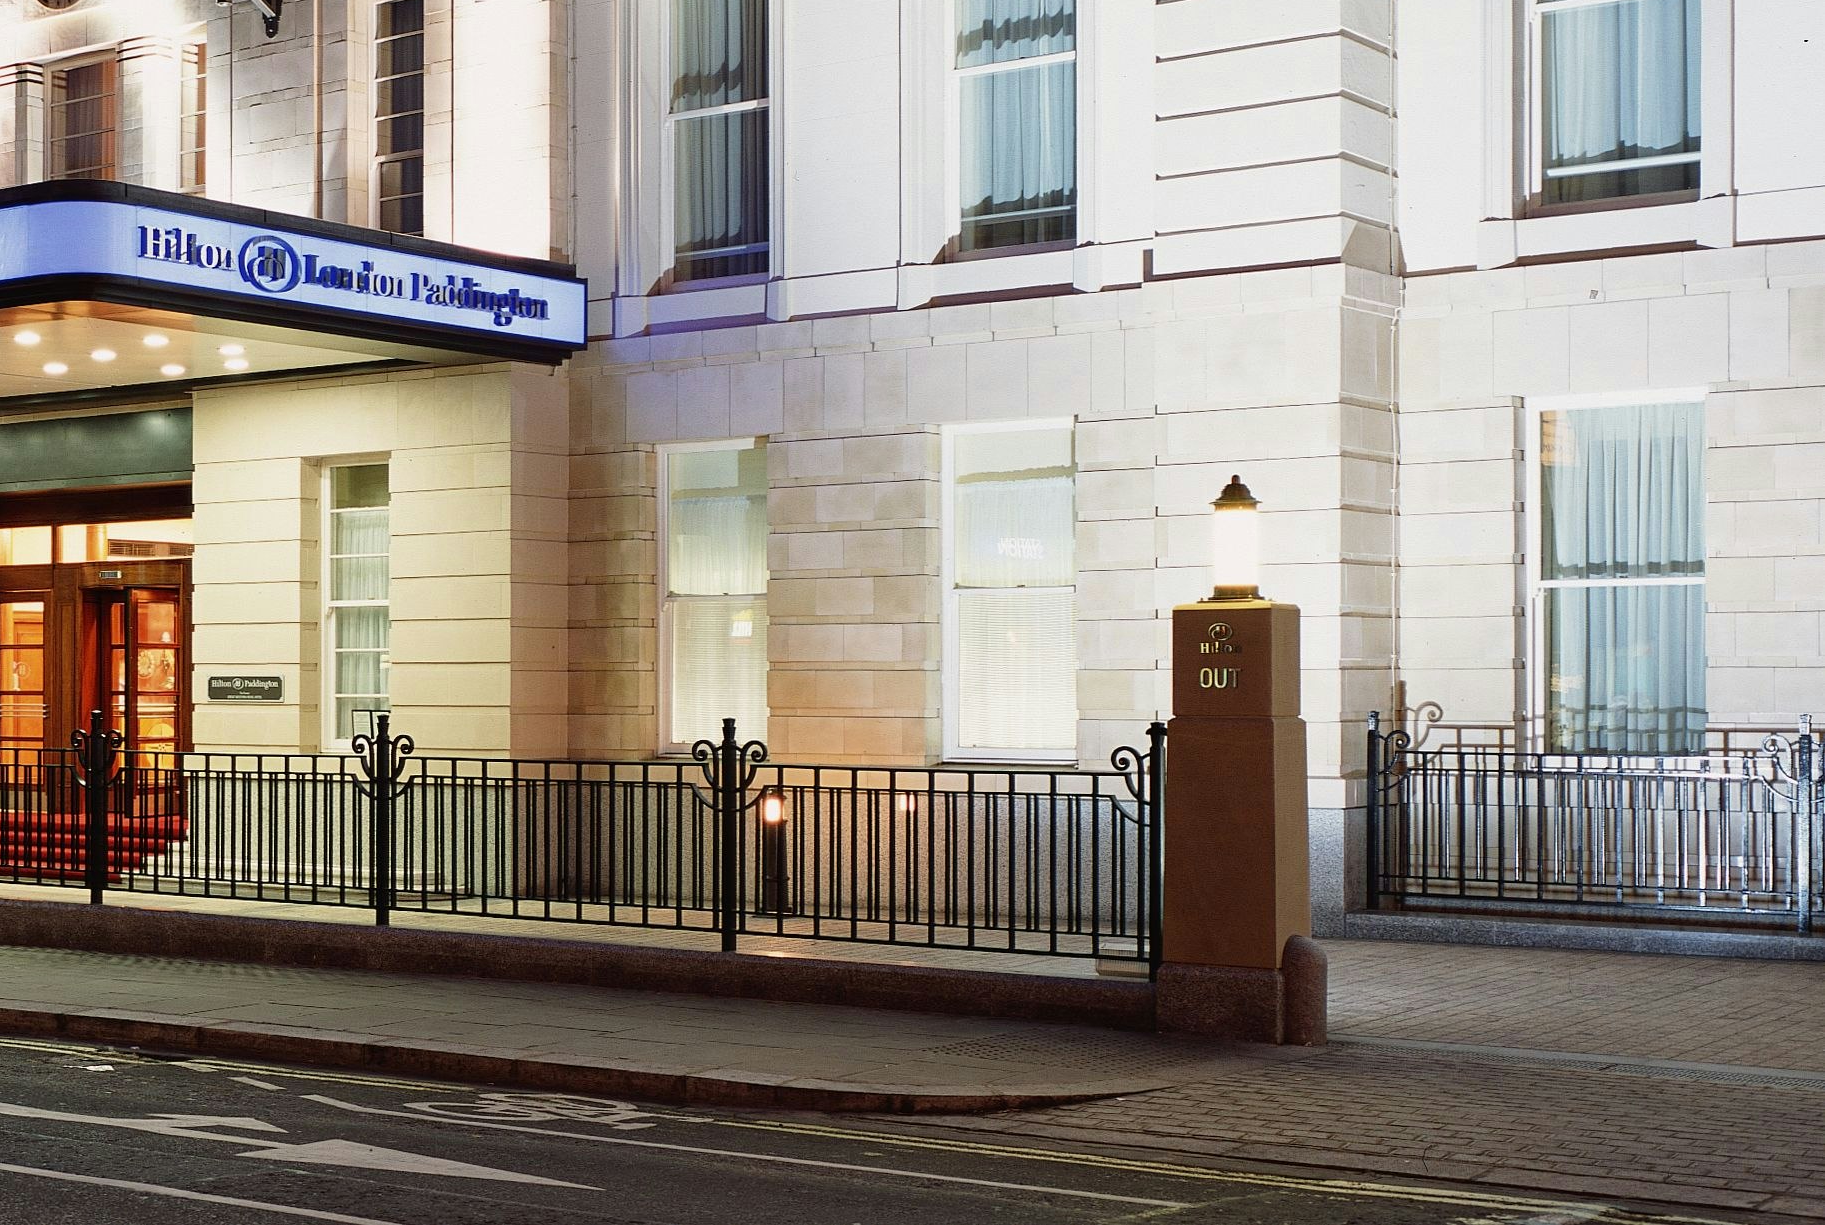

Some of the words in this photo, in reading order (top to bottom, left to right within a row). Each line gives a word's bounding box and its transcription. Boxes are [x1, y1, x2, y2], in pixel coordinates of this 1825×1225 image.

[138, 225, 237, 271] Hilton
[302, 254, 406, 299] London
[410, 272, 550, 327] Paddington
[211, 679, 232, 688] Hilton
[244, 679, 279, 691] Paddington
[1199, 667, 1241, 689] OUT
